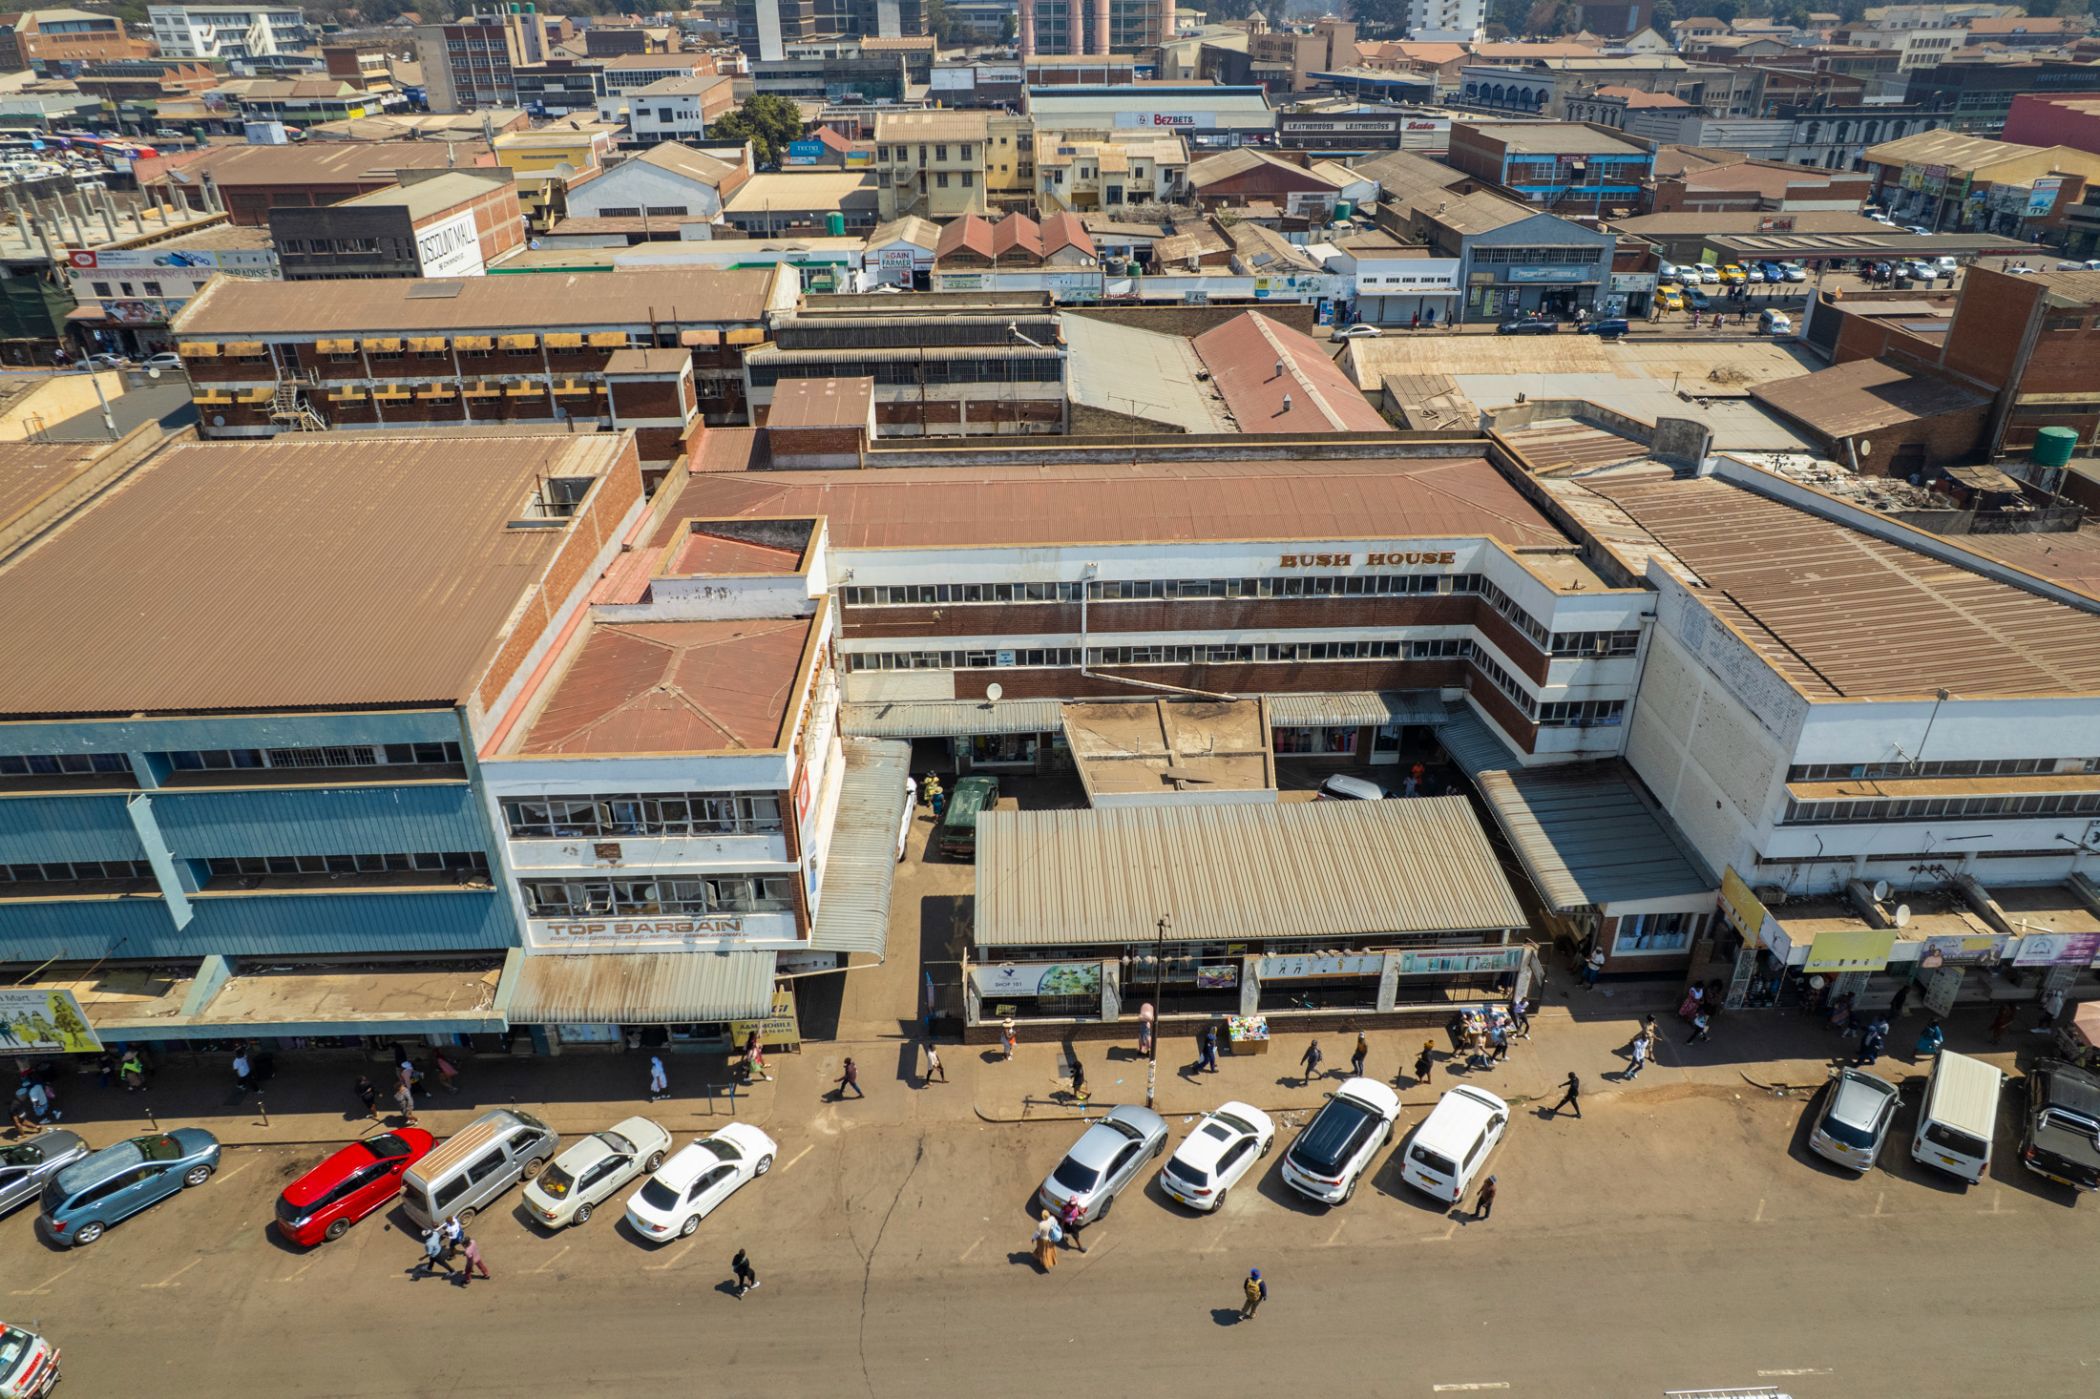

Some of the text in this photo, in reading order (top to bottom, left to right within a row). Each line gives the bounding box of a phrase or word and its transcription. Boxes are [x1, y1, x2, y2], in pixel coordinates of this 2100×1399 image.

[1407, 121, 1435, 130] Bata
[419, 228, 454, 265] DISCOUNT
[453, 220, 476, 249] MALL
[1279, 551, 1456, 568] BUSH HOUSE
[547, 920, 741, 936] TOP BARGAIN
[5, 994, 30, 1002] Mart
